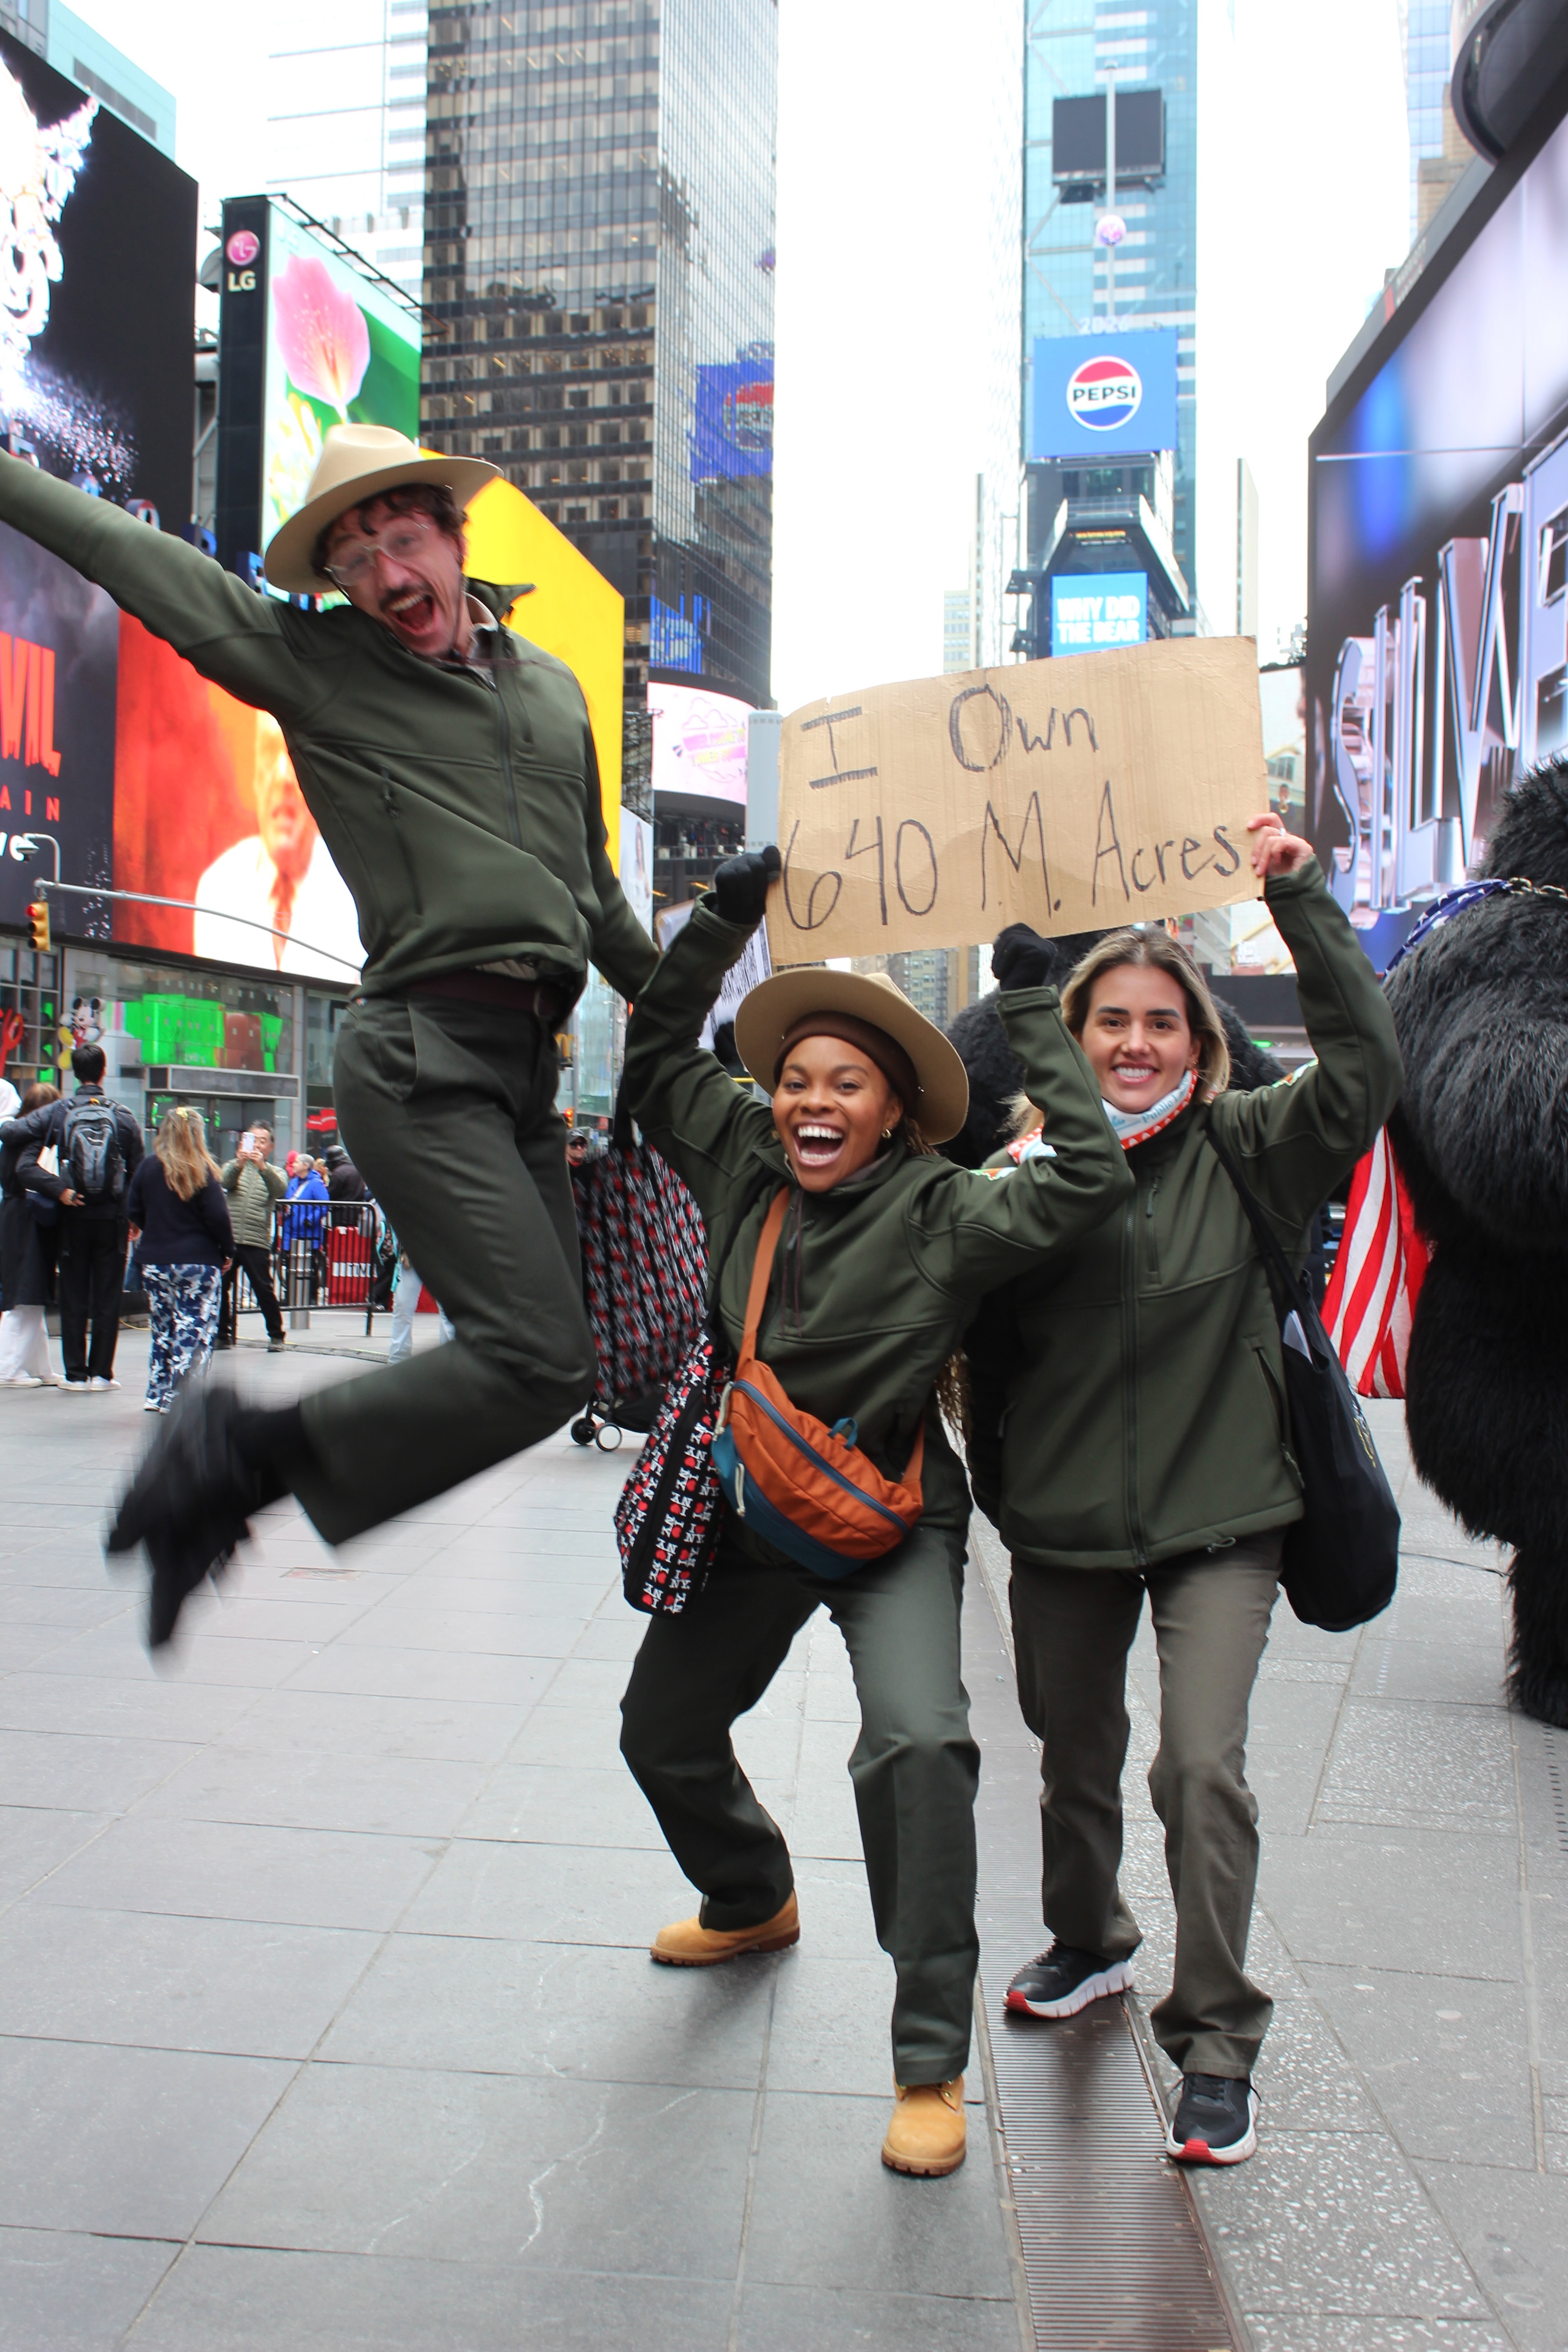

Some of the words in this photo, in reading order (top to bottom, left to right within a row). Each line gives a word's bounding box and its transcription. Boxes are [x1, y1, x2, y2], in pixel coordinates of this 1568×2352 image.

[228, 270, 256, 292] LG
[1073, 386, 1135, 402] PEPSI
[1057, 596, 1103, 622] WHY
[1105, 595, 1141, 621] DID
[1057, 622, 1092, 644] THE
[1093, 620, 1140, 643] BEAR
[801, 706, 878, 791] I
[949, 683, 1099, 772] Own
[783, 816, 938, 930] 640
[1092, 780, 1241, 908] Acres
[1142, 1099, 1173, 1123] Public
